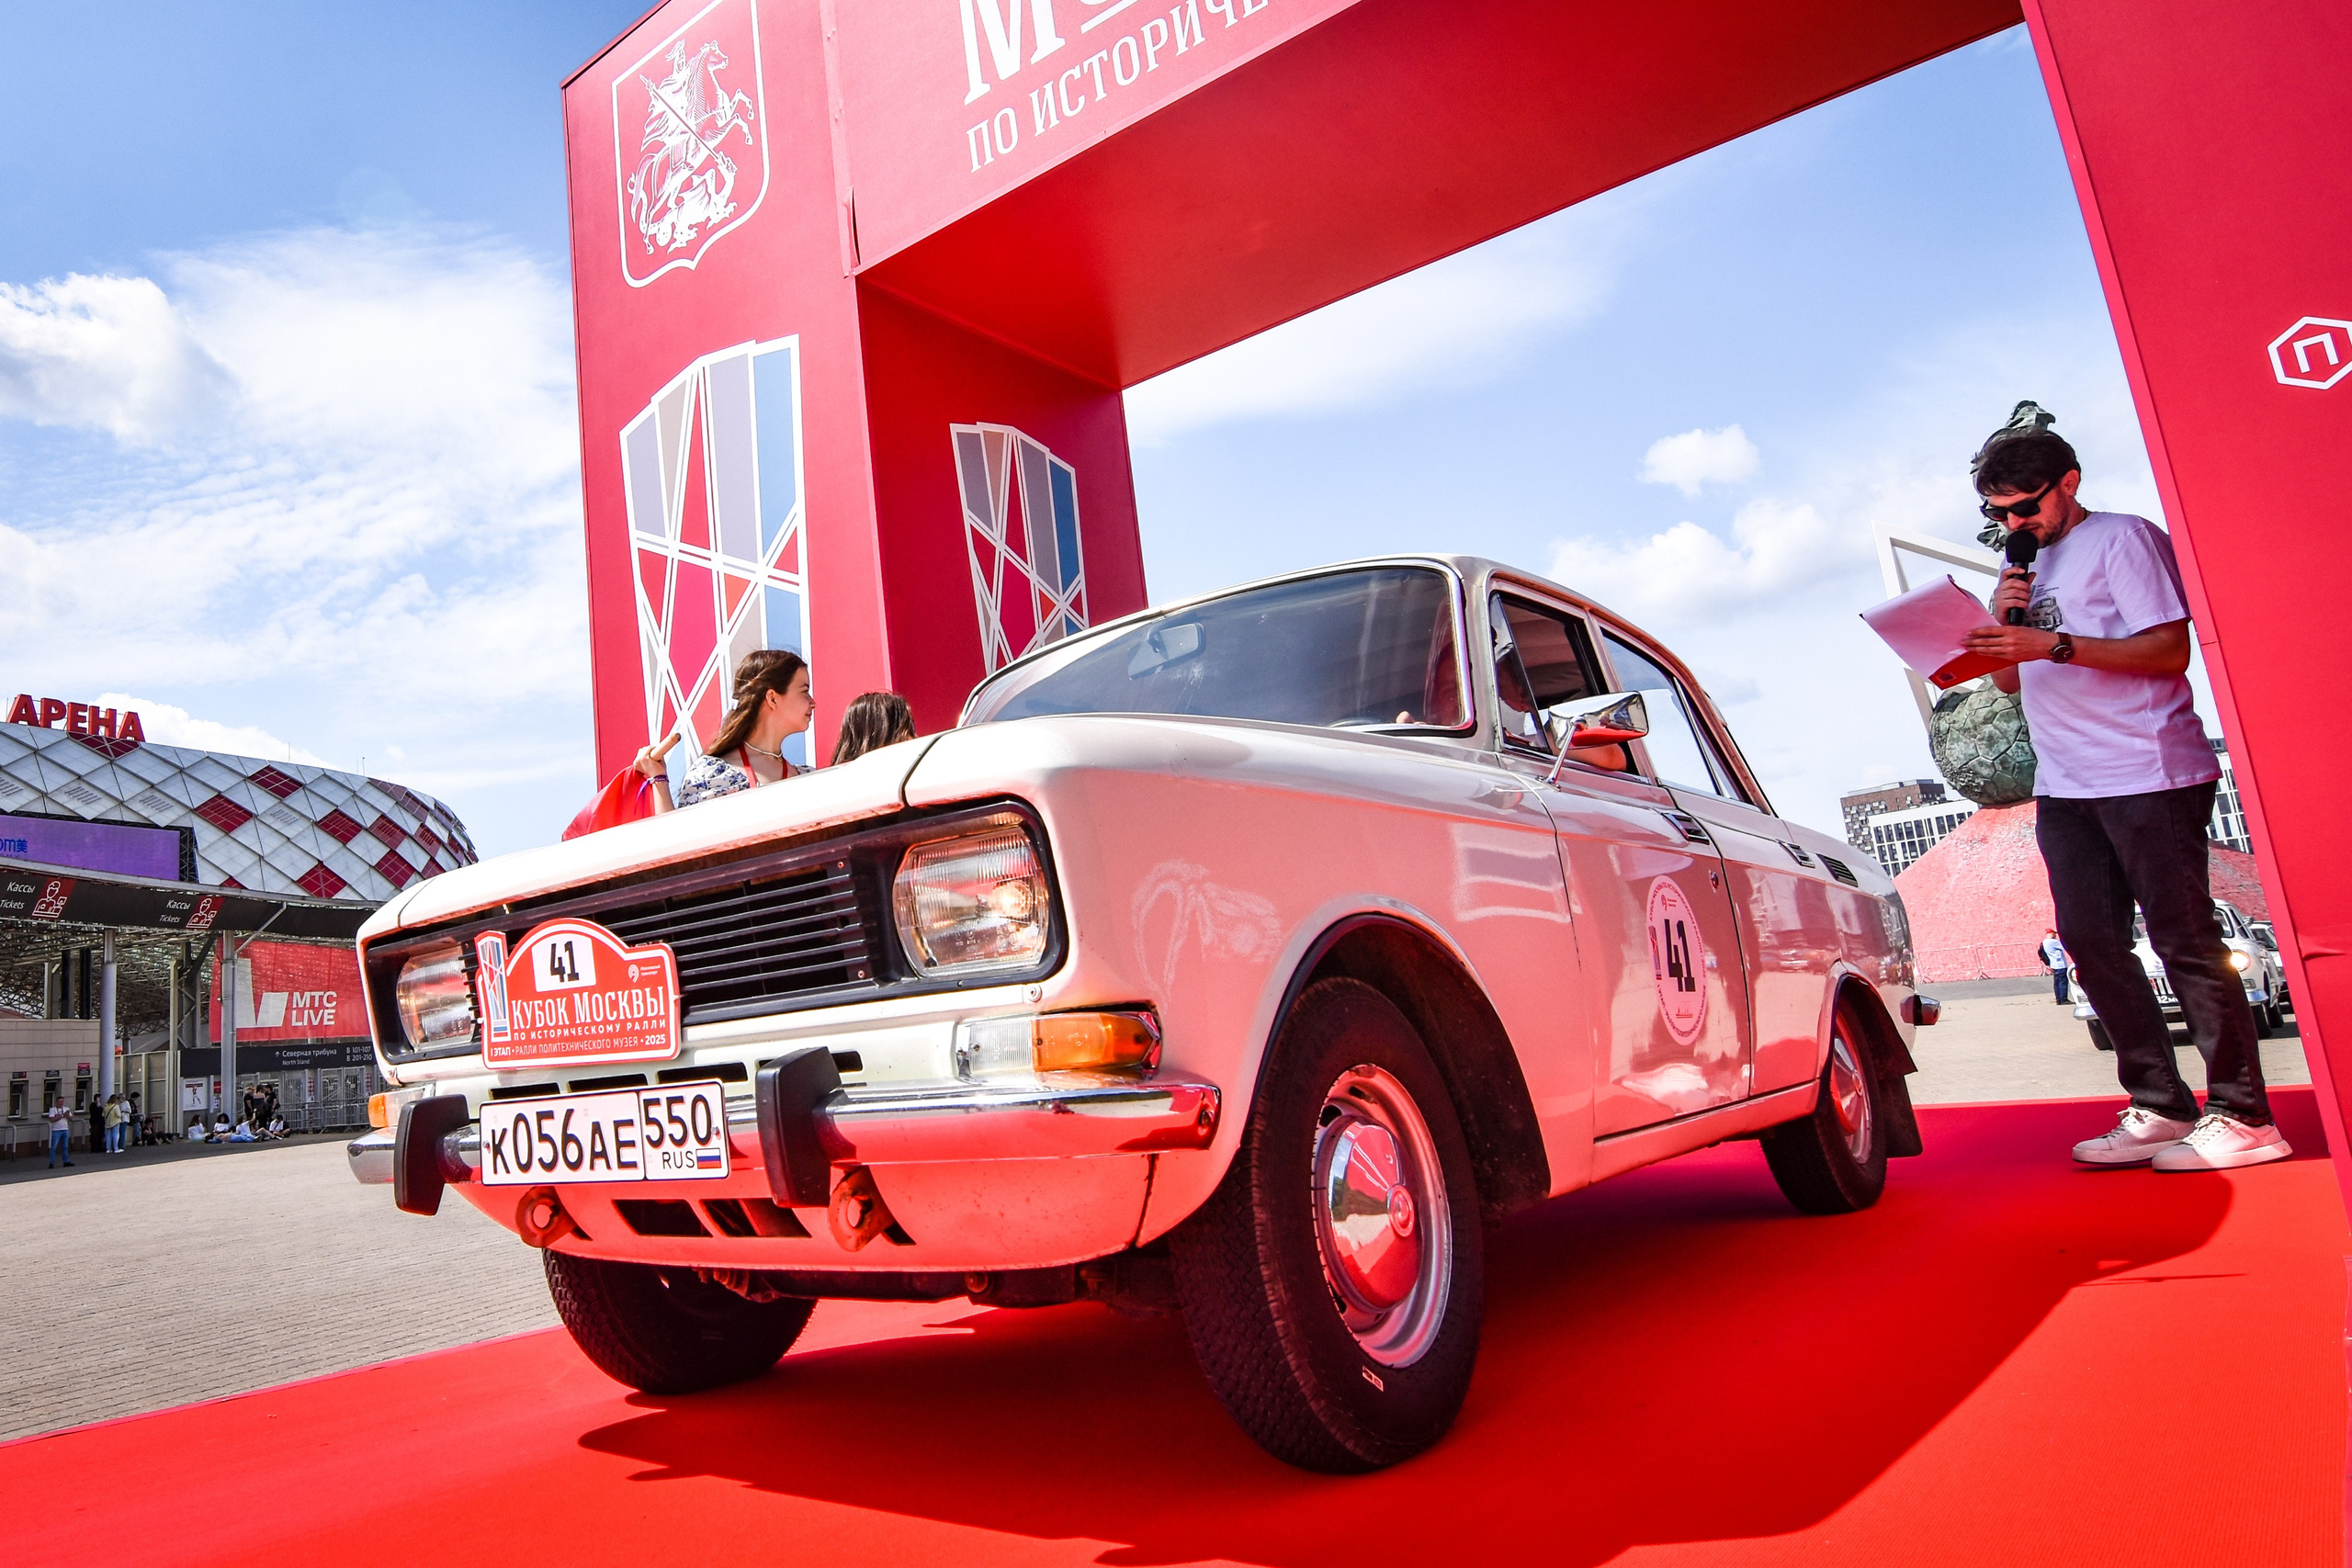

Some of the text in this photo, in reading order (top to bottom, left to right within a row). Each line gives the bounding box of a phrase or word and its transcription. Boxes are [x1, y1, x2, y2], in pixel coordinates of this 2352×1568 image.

[966, 107, 1019, 173] ПО
[6, 694, 145, 742] АРЕНА
[6, 881, 36, 894] Кассы
[0, 899, 25, 909] Tickets
[166, 899, 191, 910] Кассы
[159, 914, 181, 923] Tickets
[550, 941, 580, 983] 41
[1664, 919, 1696, 992] 41
[292, 991, 337, 1009] МТС
[512, 986, 665, 1030] КУБОК МОСКВЫ
[291, 1009, 336, 1027] LIVE
[514, 1019, 666, 1041] ПО ИСТОРИЧЕСКОМУ РАЛЛИ
[282, 1048, 337, 1058] Северная трибуна
[493, 1046, 511, 1056] ЭТАП
[515, 1044, 537, 1055] РАЛЛИ
[539, 1039, 611, 1054] ПОЛИТЕХНИЧЕСКОГО
[613, 1036, 639, 1048] МУЗЕЯ
[645, 1034, 666, 1045] 2025
[643, 1094, 713, 1148] 550
[662, 1150, 695, 1169] RUS
